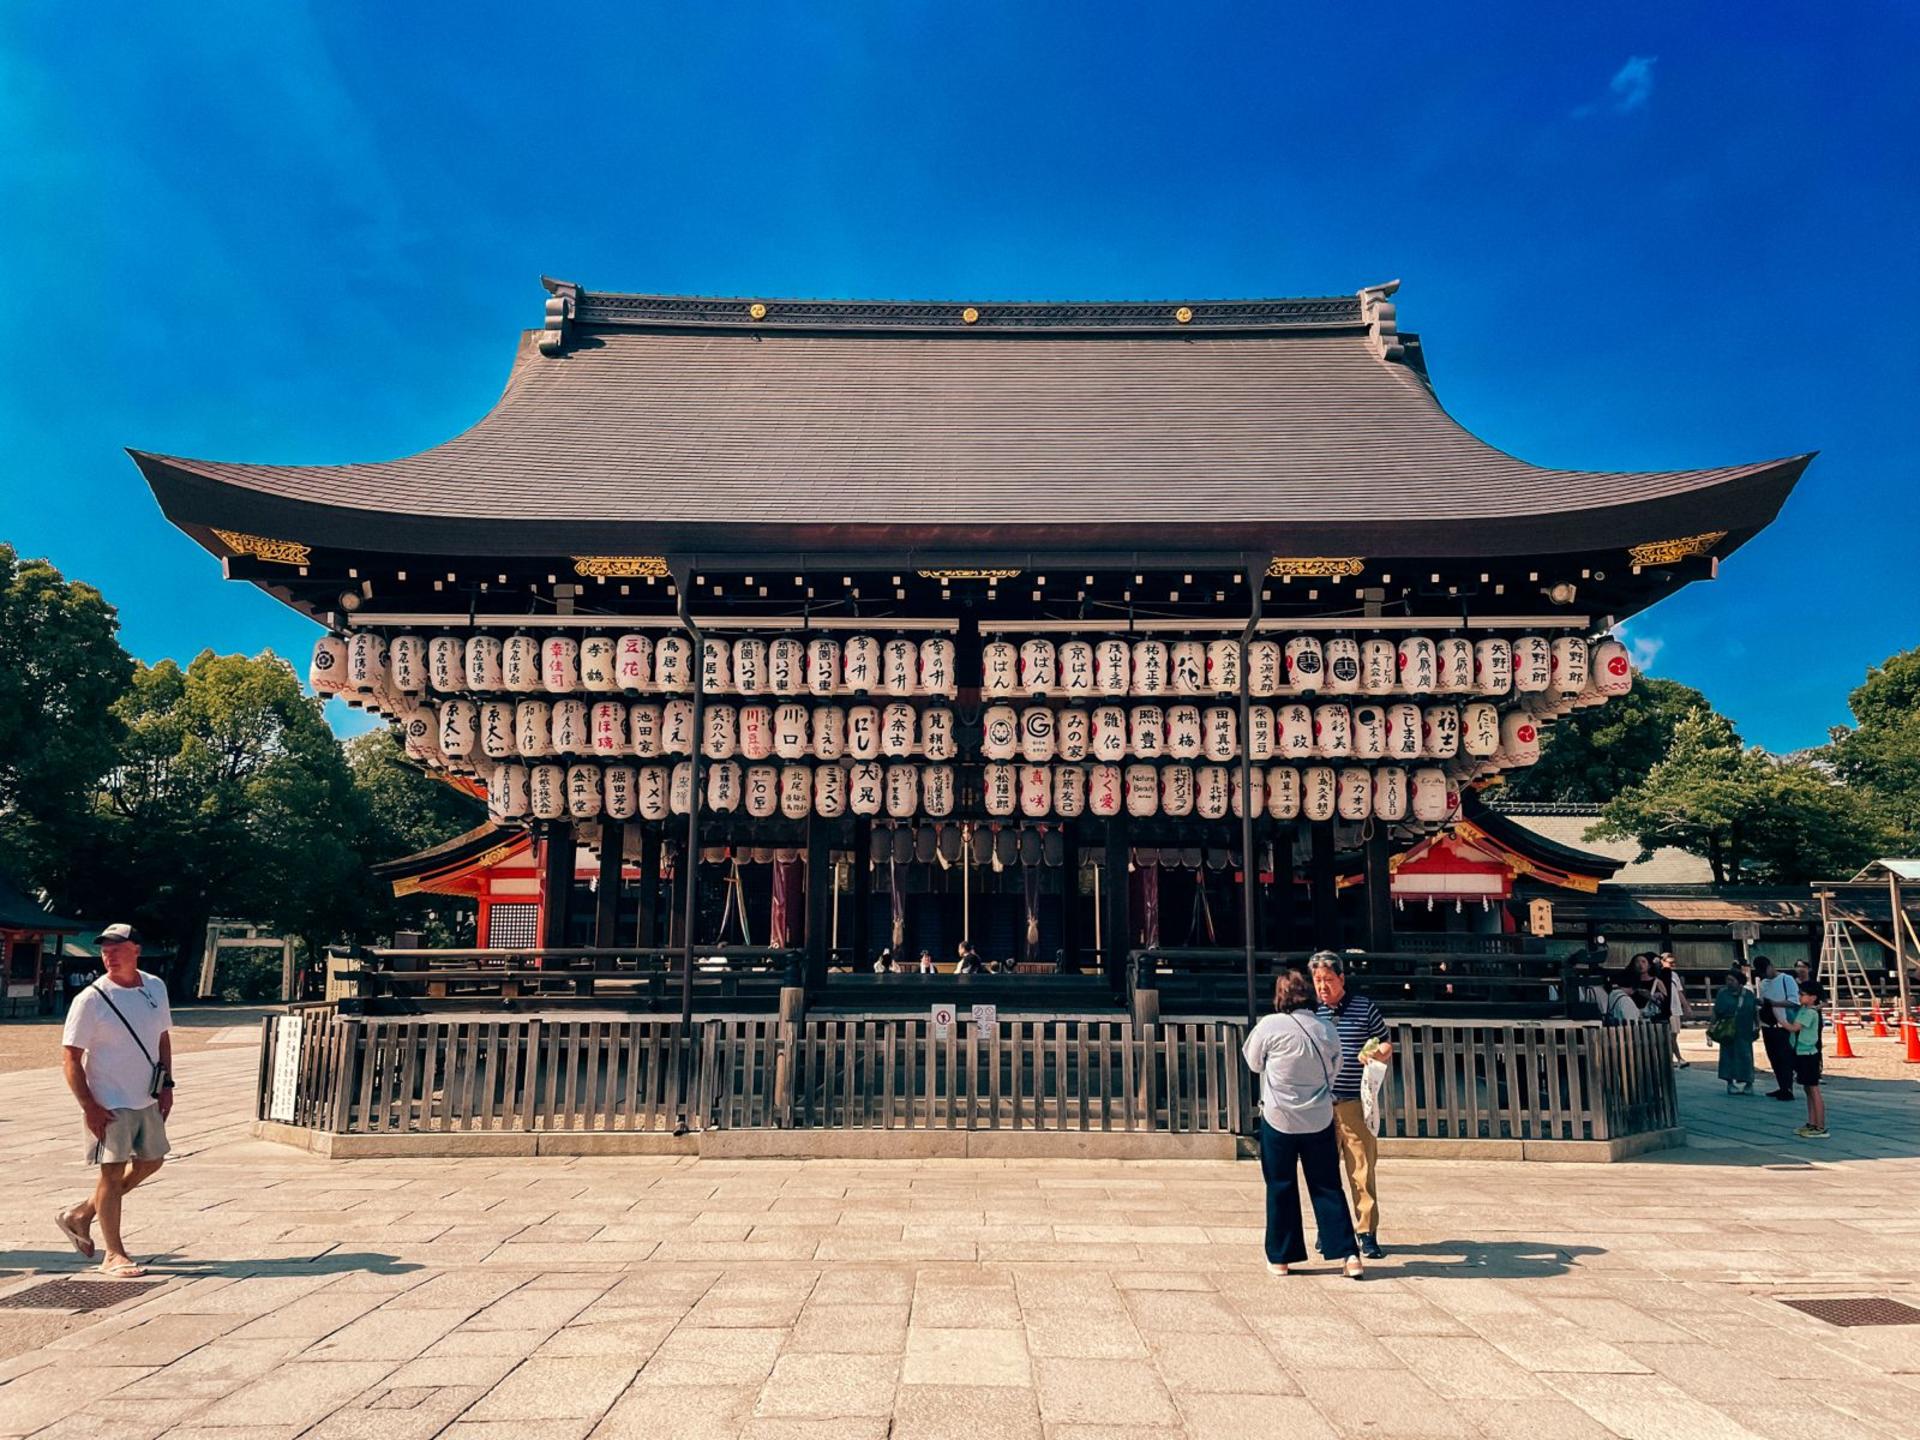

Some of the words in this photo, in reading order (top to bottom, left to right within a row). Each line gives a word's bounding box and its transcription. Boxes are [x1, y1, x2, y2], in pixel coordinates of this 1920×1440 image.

[622, 639, 639, 676] 豆花
[663, 639, 679, 684] 鳥居本
[704, 644, 719, 688] 鳥居本
[1491, 644, 1507, 689] 矢野一郎
[1531, 638, 1547, 684] 矢野一郎
[1568, 638, 1584, 684] 矢野一郎
[637, 711, 652, 753] 池田家
[783, 709, 799, 745] 川口
[855, 717, 870, 751] にし
[890, 707, 907, 747] 元奈古
[1067, 714, 1084, 758] みの家
[1400, 706, 1416, 752] こじま屋
[647, 770, 661, 813] キメラ
[1352, 784, 1365, 815] カオス
